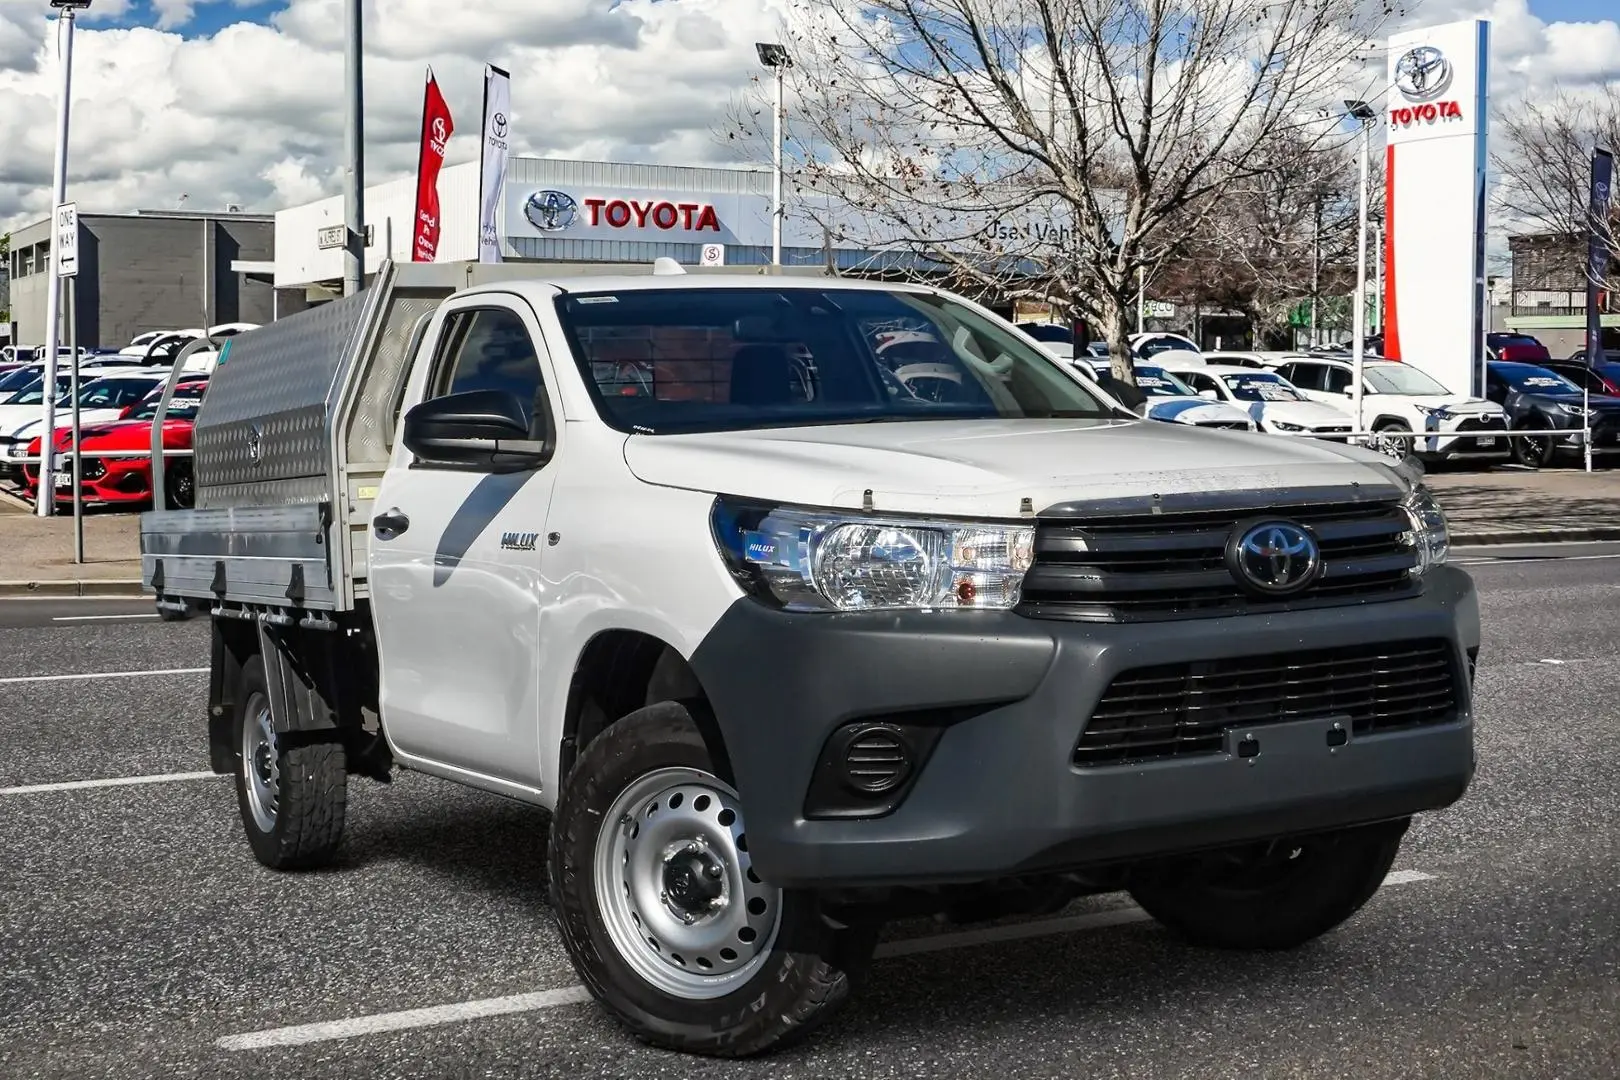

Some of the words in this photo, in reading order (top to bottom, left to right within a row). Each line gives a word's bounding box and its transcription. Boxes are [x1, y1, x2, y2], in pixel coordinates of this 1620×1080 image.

[1389, 101, 1462, 125] TOYOTA
[60, 209, 74, 227] ONE
[584, 199, 720, 232] TOYOTA
[60, 231, 75, 249] WAY
[501, 532, 539, 546] HILUX
[749, 543, 775, 553] HILUX
